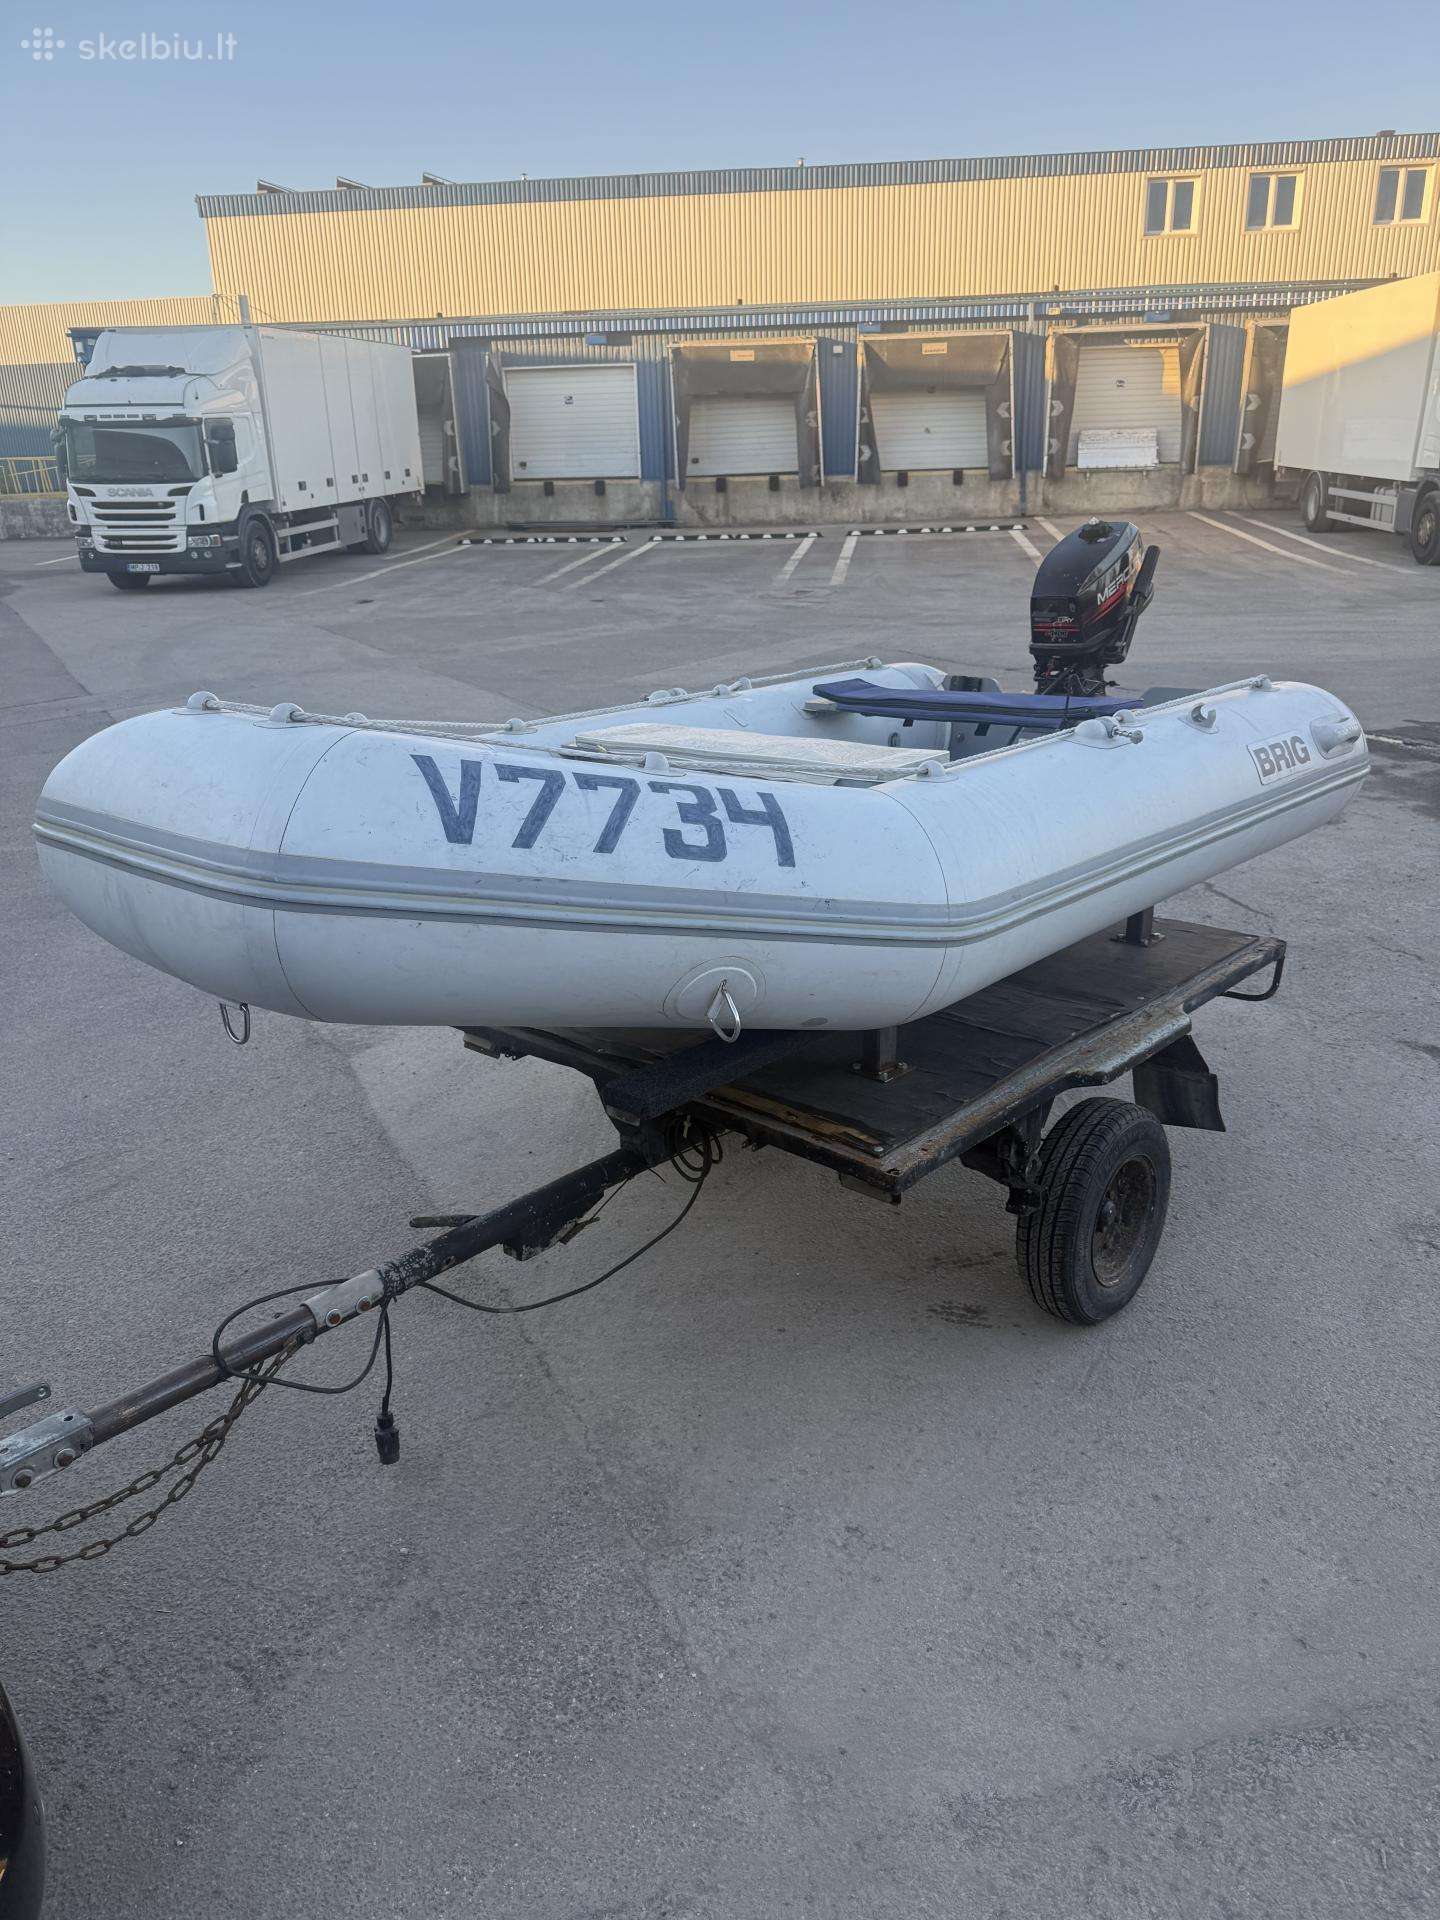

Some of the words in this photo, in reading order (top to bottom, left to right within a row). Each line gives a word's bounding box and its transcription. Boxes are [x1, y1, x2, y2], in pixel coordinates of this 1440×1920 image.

[106, 487, 154, 498] SCANIA
[1096, 565, 1137, 606] MERC
[1252, 735, 1312, 778] BRIG
[409, 753, 796, 868] V7734
